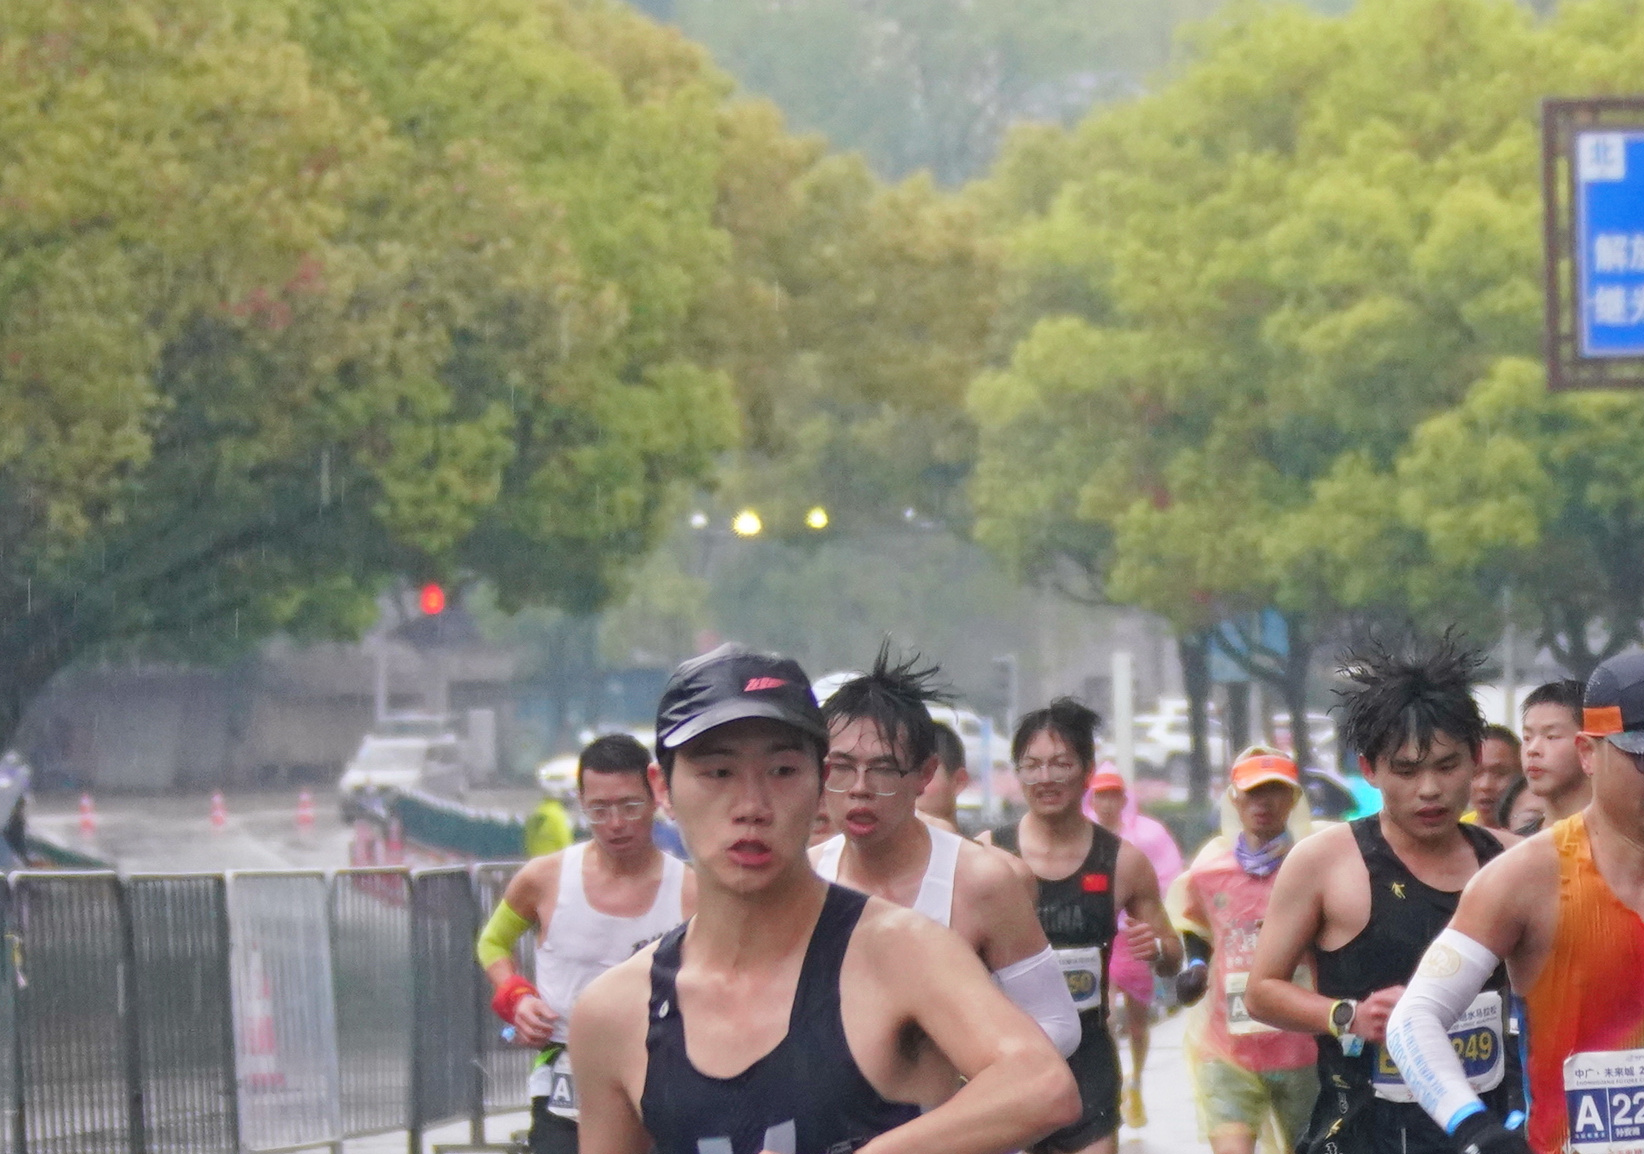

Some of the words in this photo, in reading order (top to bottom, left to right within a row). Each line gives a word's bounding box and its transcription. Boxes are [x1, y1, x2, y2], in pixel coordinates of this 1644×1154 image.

[1450, 1032, 1493, 1061] 249
[553, 1077, 572, 1102] A
[1575, 1095, 1605, 1132] A
